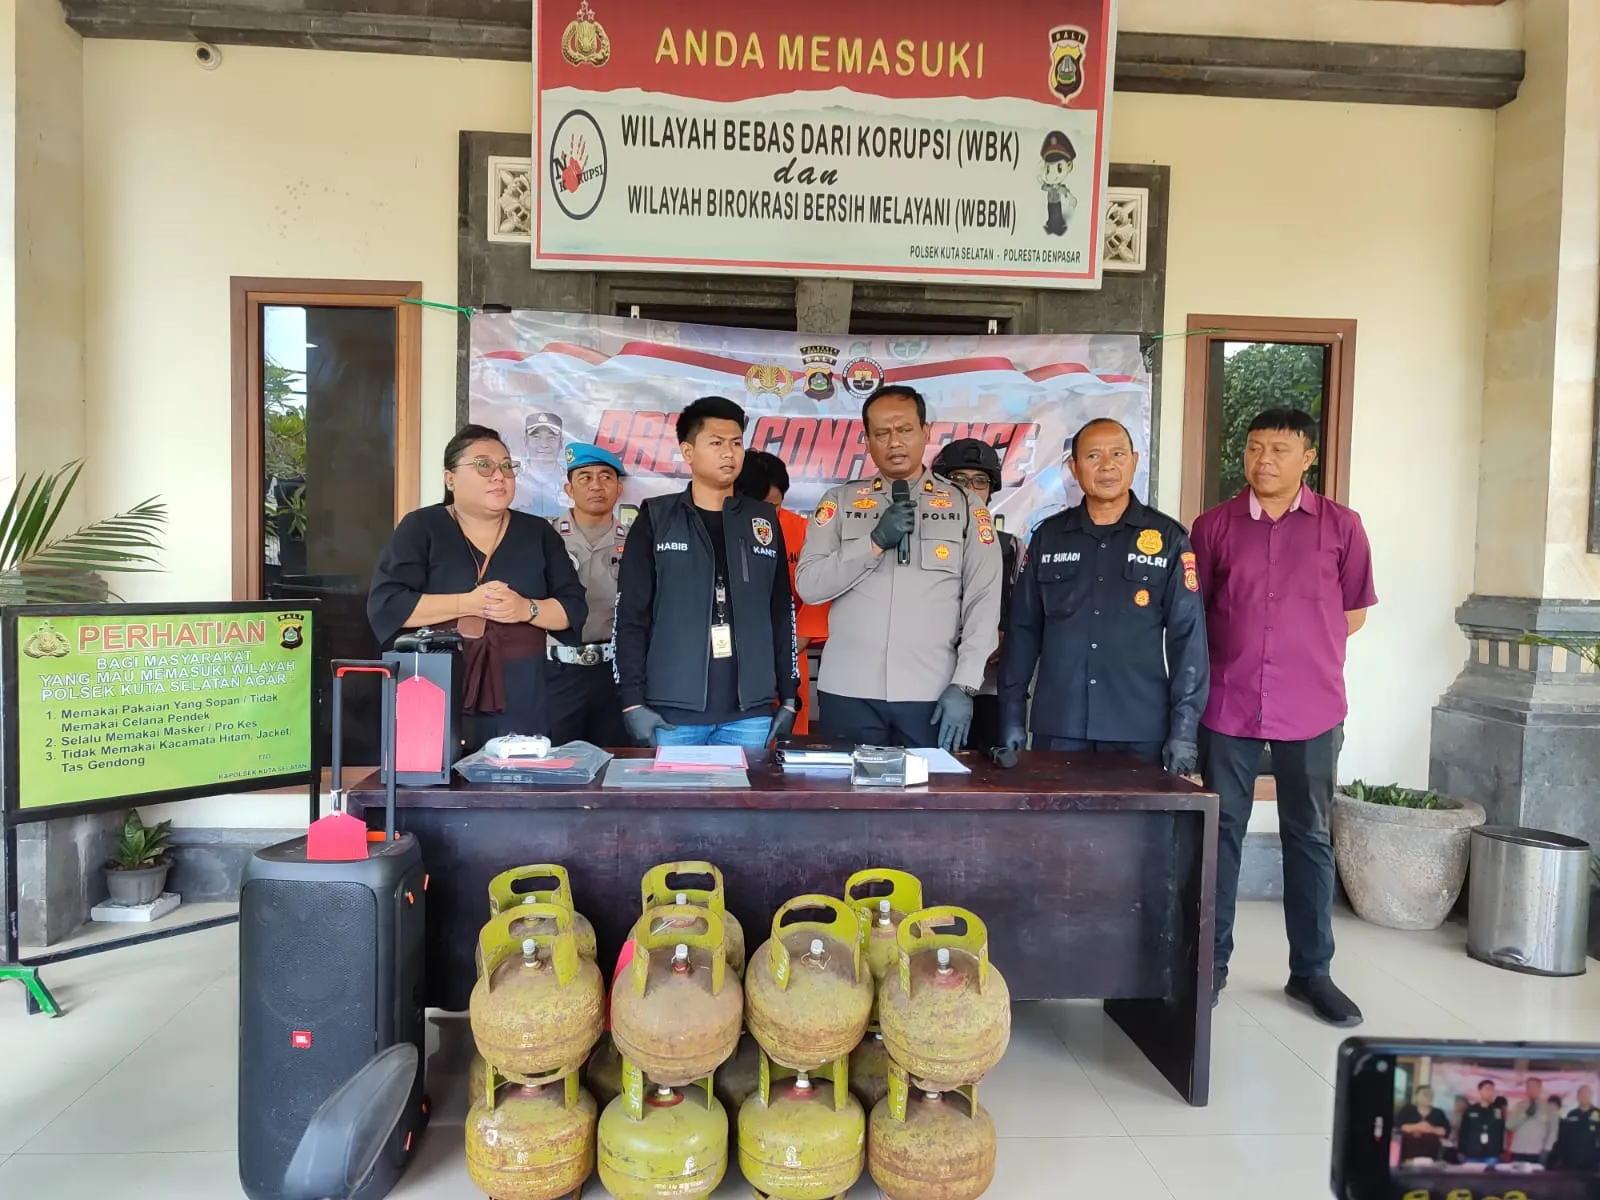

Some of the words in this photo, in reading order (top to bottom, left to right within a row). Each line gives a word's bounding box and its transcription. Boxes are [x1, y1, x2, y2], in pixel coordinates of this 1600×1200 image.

[1055, 31, 1082, 41] BALI
[655, 27, 765, 69] ANDA
[778, 34, 985, 79] MEMASUKI
[621, 114, 717, 150] WILAYAH
[723, 120, 795, 154] BEBAS
[801, 123, 851, 157] DARI
[857, 126, 951, 161] KORUPSI
[958, 129, 1020, 170] (WBK)
[774, 157, 839, 186] dan
[628, 185, 701, 217] WILAYAH
[706, 188, 798, 220] BIROKRASI
[803, 192, 865, 223] BERSIH
[869, 195, 950, 227] MELAYANI
[955, 198, 1017, 235] (WBBM)
[910, 245, 938, 259] POLSEK
[940, 246, 960, 259] KUTA
[961, 247, 994, 260] SELATAN
[1003, 248, 1041, 262] POLRESTA
[1042, 250, 1081, 263] DENPASAR
[846, 511, 867, 519] TRI
[922, 512, 960, 521] POLRI
[656, 542, 689, 551] HABIB
[1041, 553, 1052, 564] KT
[1053, 551, 1081, 563] SUKADI
[1128, 553, 1168, 568] POLRI
[78, 619, 266, 651] PERHATIAN
[96, 656, 138, 670] BAGI
[144, 650, 251, 669] MASYARAKAT
[40, 673, 90, 687] YANG
[97, 669, 134, 684] MAU
[141, 665, 227, 681] MEMASUKI
[232, 660, 295, 676] WILAYAH
[41, 685, 115, 702] POLSEK
[121, 683, 166, 696] KUTA
[170, 678, 240, 692] SELATAN
[245, 674, 287, 687] AGAR
[46, 711, 56, 720] 1.
[61, 705, 118, 719] Memakai
[122, 702, 169, 714] Pakaian
[173, 700, 202, 711] Yang
[205, 697, 240, 707] Sopan
[250, 694, 278, 703] Tidak
[61, 719, 118, 732] Memakai
[122, 717, 164, 728] Celana
[167, 712, 210, 724] Pendek
[45, 738, 56, 748] 2.
[61, 735, 101, 746] Selalu
[106, 729, 159, 742] Memakai
[163, 725, 205, 736] Masker
[215, 722, 234, 731] Pro
[237, 720, 258, 729] Kes
[46, 752, 56, 761] 3.
[62, 748, 96, 759] Tidak
[100, 743, 155, 756] Memakai
[159, 736, 216, 749] Kacamata
[62, 762, 84, 773] Tas
[88, 756, 145, 771] Gendong
[258, 767, 277, 775] KUTA
